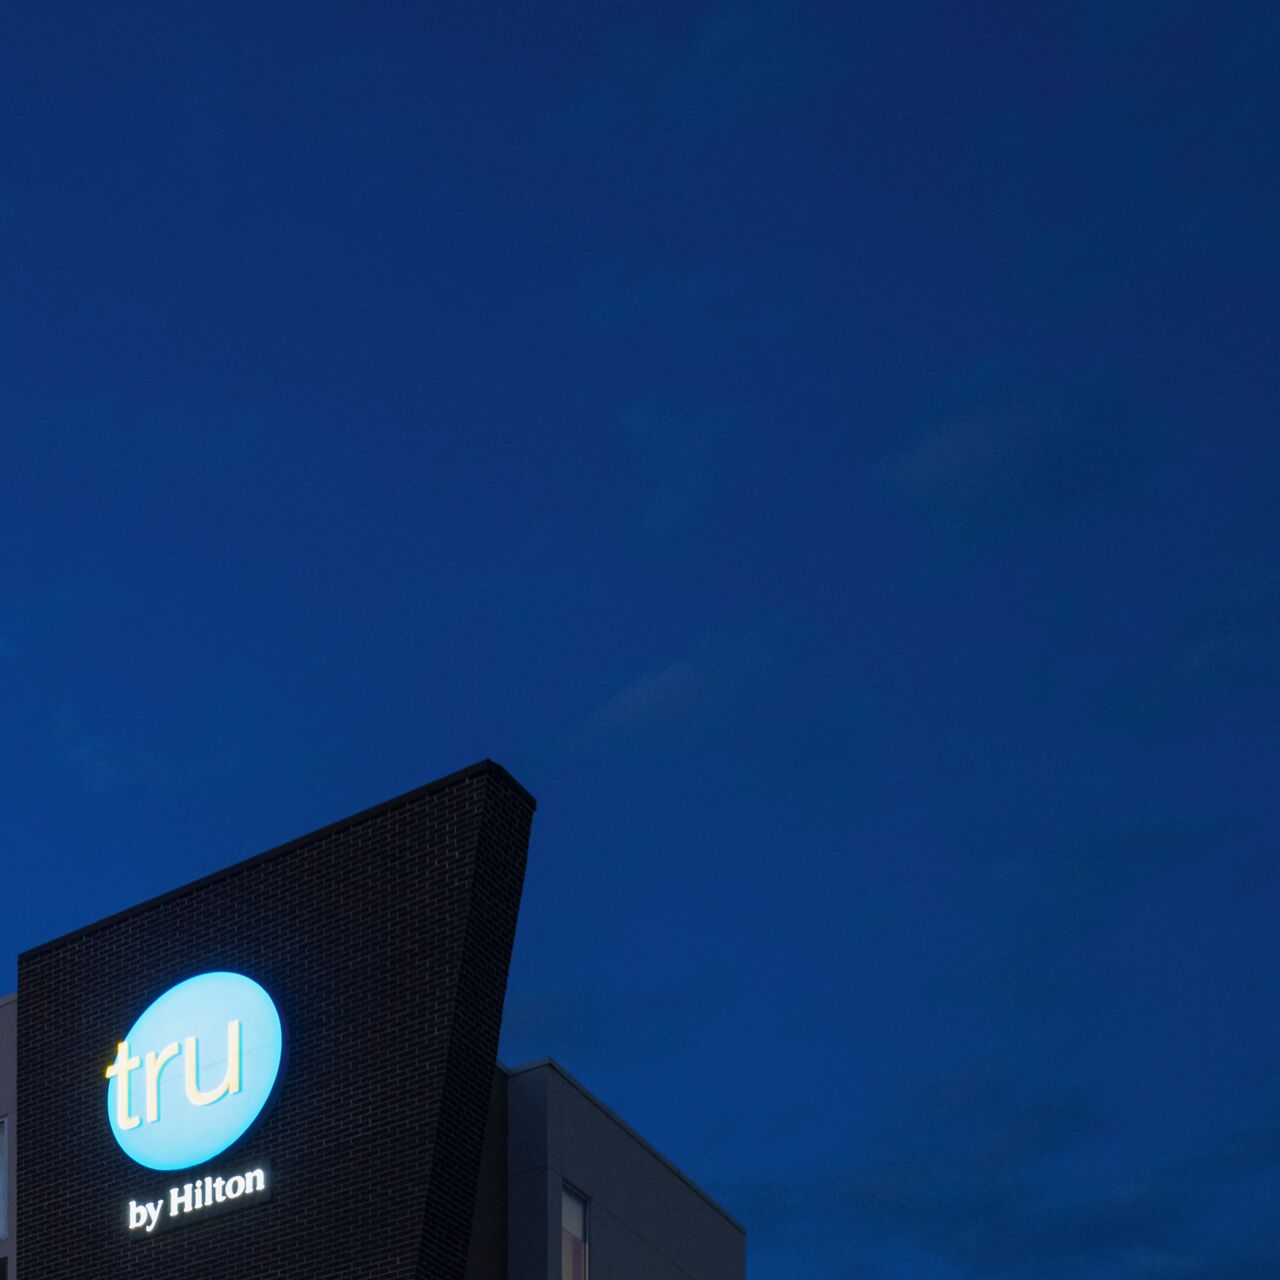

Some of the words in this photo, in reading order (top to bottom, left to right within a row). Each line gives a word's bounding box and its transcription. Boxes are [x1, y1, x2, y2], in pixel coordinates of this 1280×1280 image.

[105, 1019, 241, 1131] tru
[128, 1200, 164, 1232] by
[169, 1167, 266, 1218] Hilton
